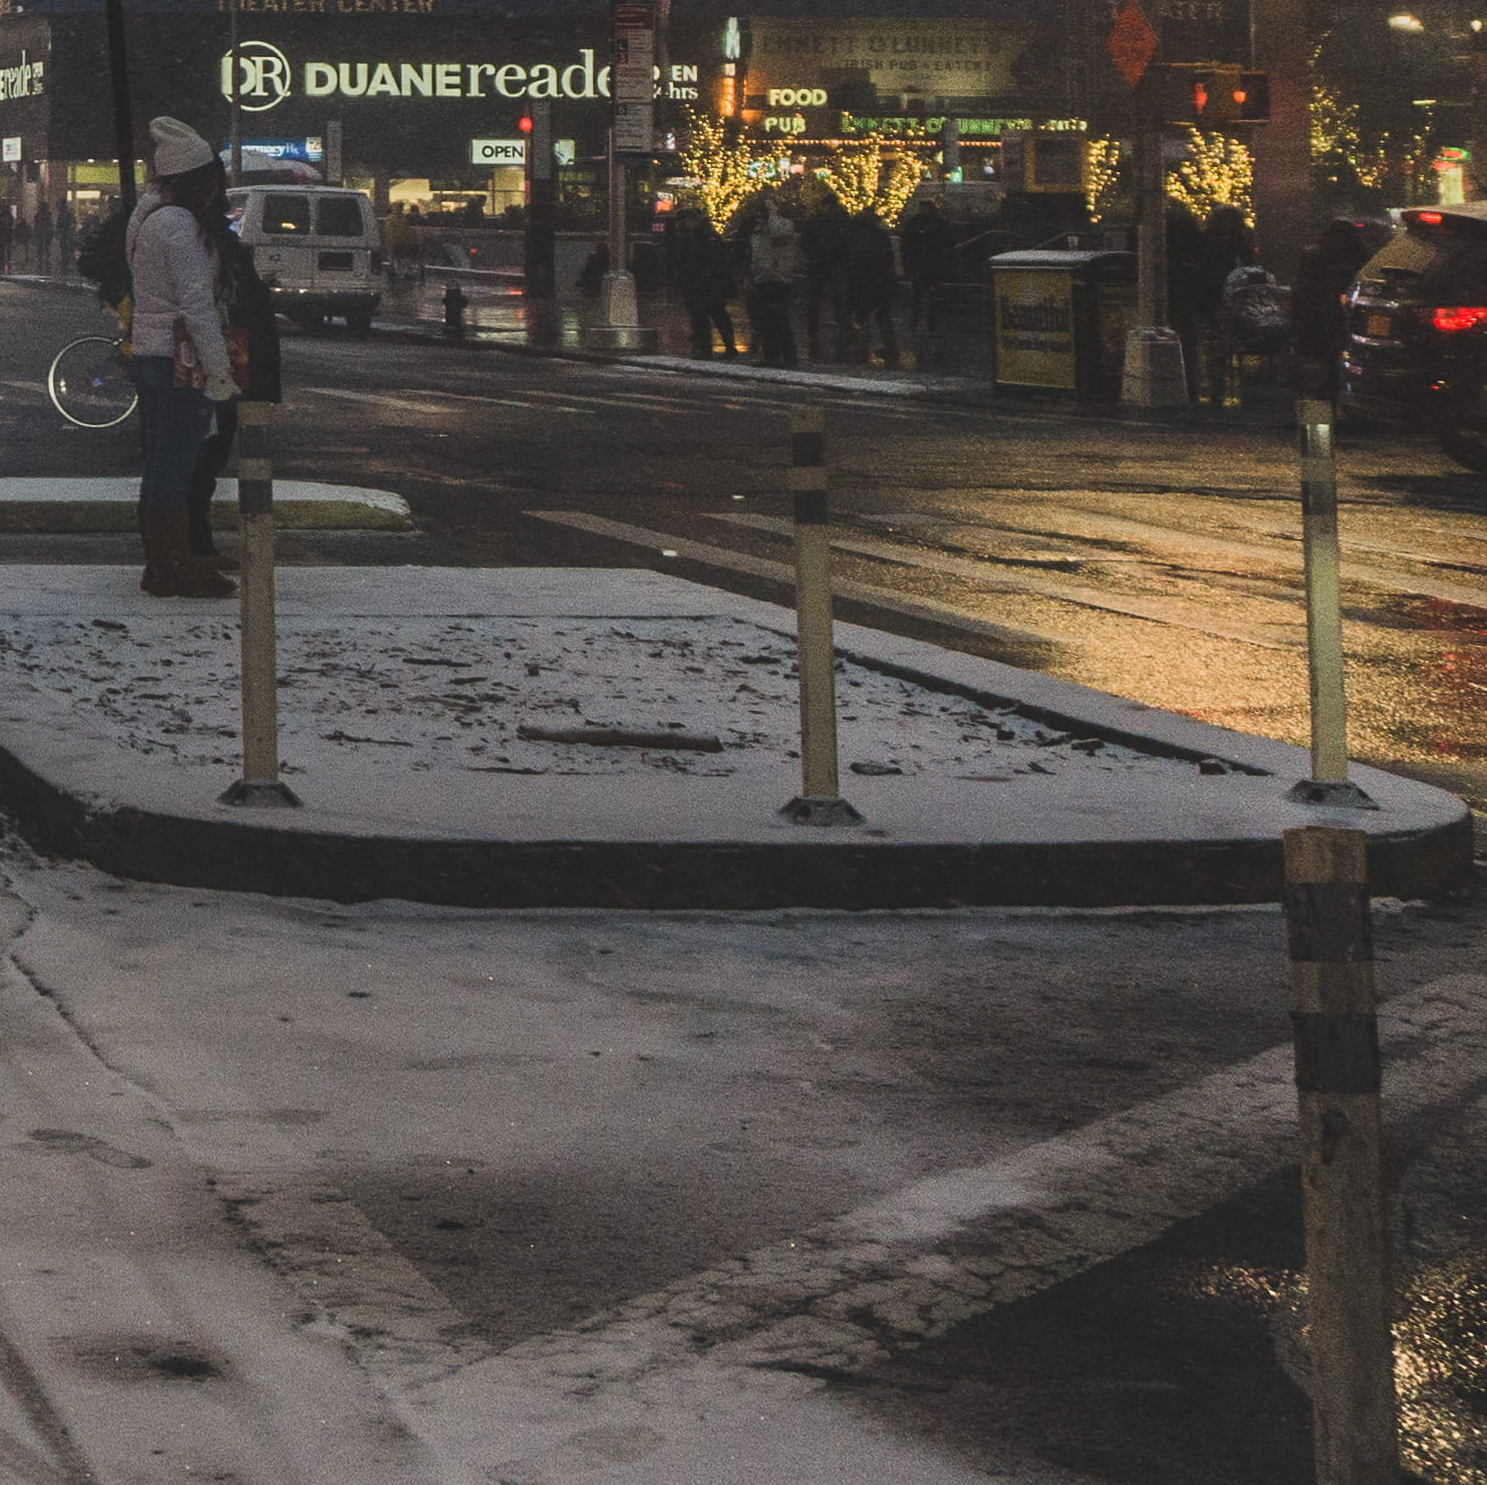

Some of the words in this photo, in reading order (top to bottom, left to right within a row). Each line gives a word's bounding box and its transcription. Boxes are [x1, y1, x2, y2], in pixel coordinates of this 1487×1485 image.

[889, 60, 918, 71] PUB
[305, 62, 462, 98] DUANE
[768, 87, 829, 107] FOOD
[763, 116, 807, 135] PUB
[482, 145, 524, 159] OPEN
